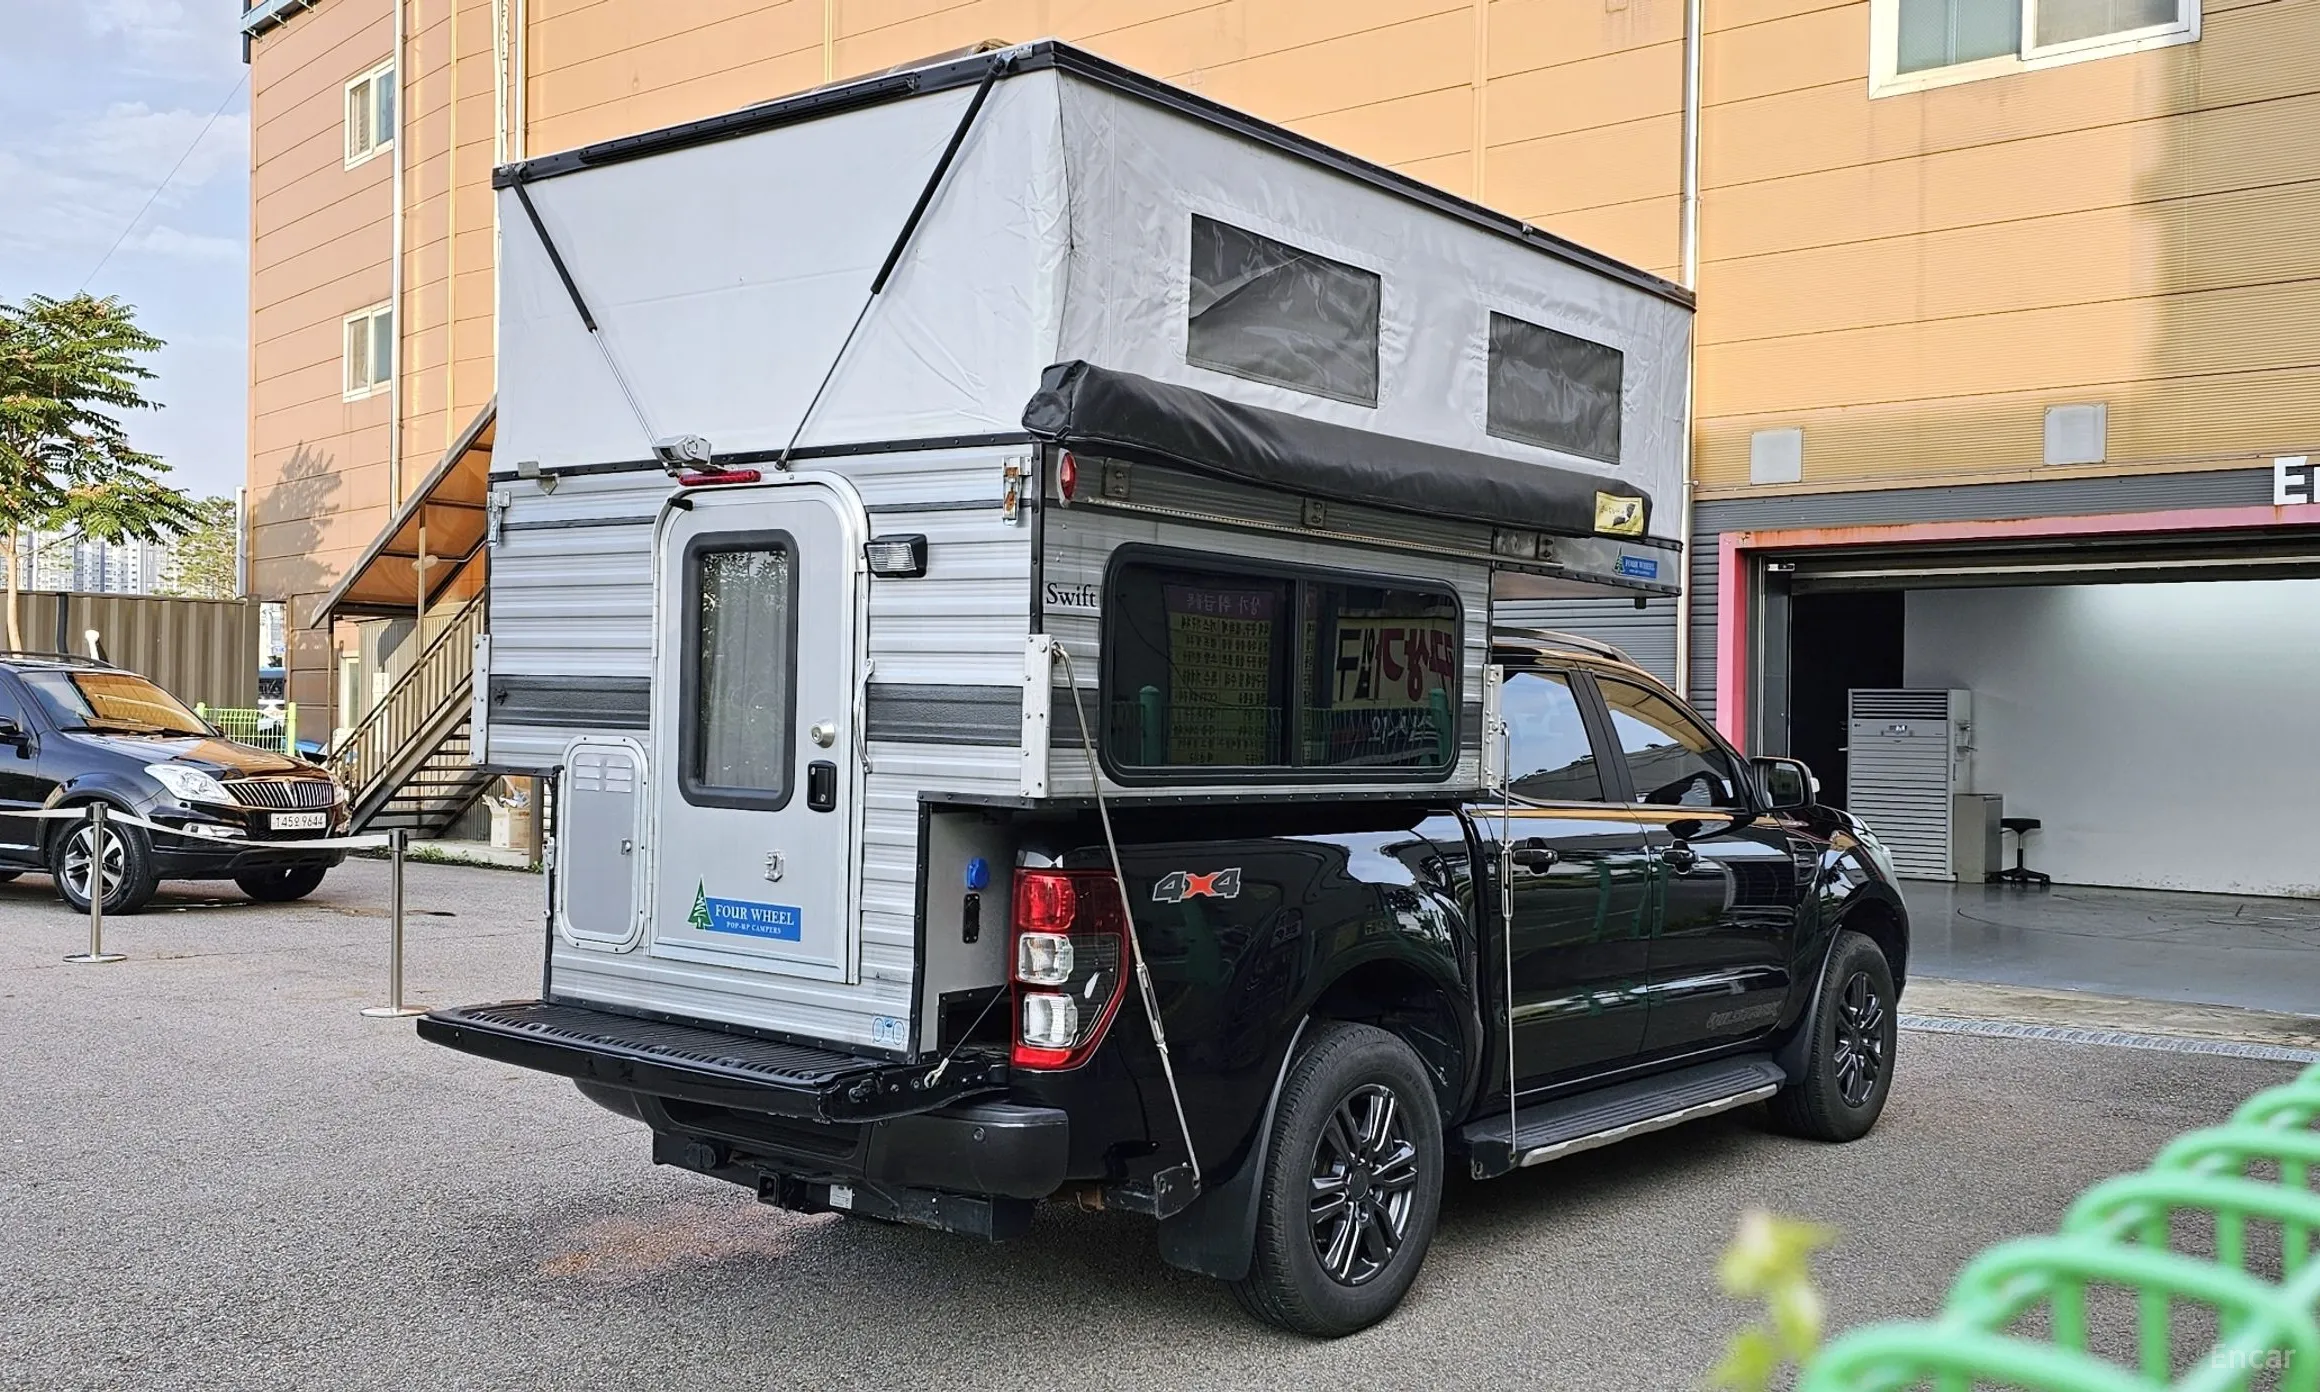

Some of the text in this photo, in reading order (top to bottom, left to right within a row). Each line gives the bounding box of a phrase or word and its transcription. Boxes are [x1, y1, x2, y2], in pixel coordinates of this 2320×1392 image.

[2274, 456, 2320, 505] E
[1046, 582, 1098, 608] Swift
[714, 903, 795, 927] FOUR WHEEL
[751, 924, 782, 934] CAMPERS
